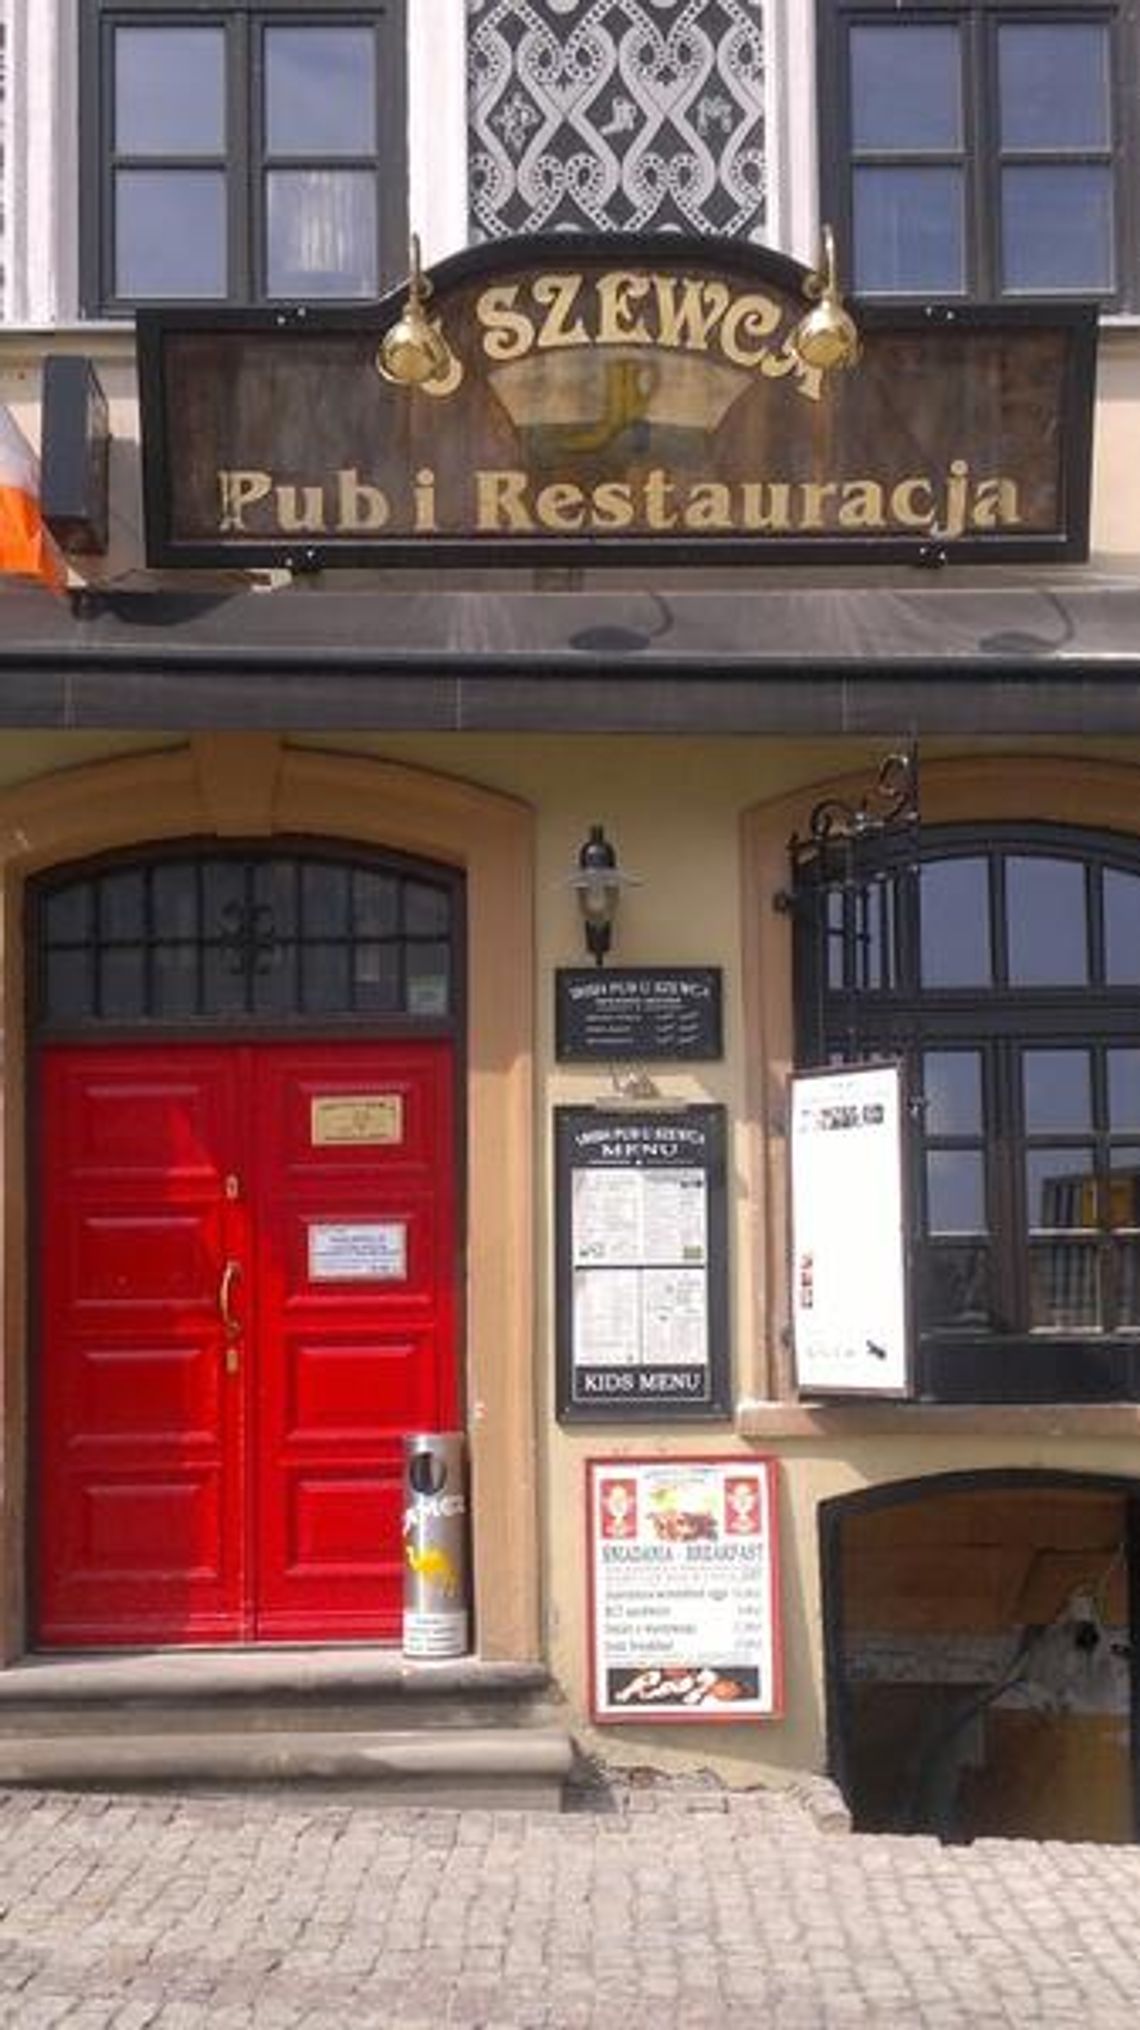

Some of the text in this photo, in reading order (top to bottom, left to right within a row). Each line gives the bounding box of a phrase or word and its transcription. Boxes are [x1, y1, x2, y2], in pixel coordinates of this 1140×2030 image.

[218, 459, 1021, 539] Pub i Restauracja
[600, 1143, 680, 1158] MENU
[583, 1373, 701, 1392] KIDS MENU
[686, 1542, 763, 1562] BREAKFAST
